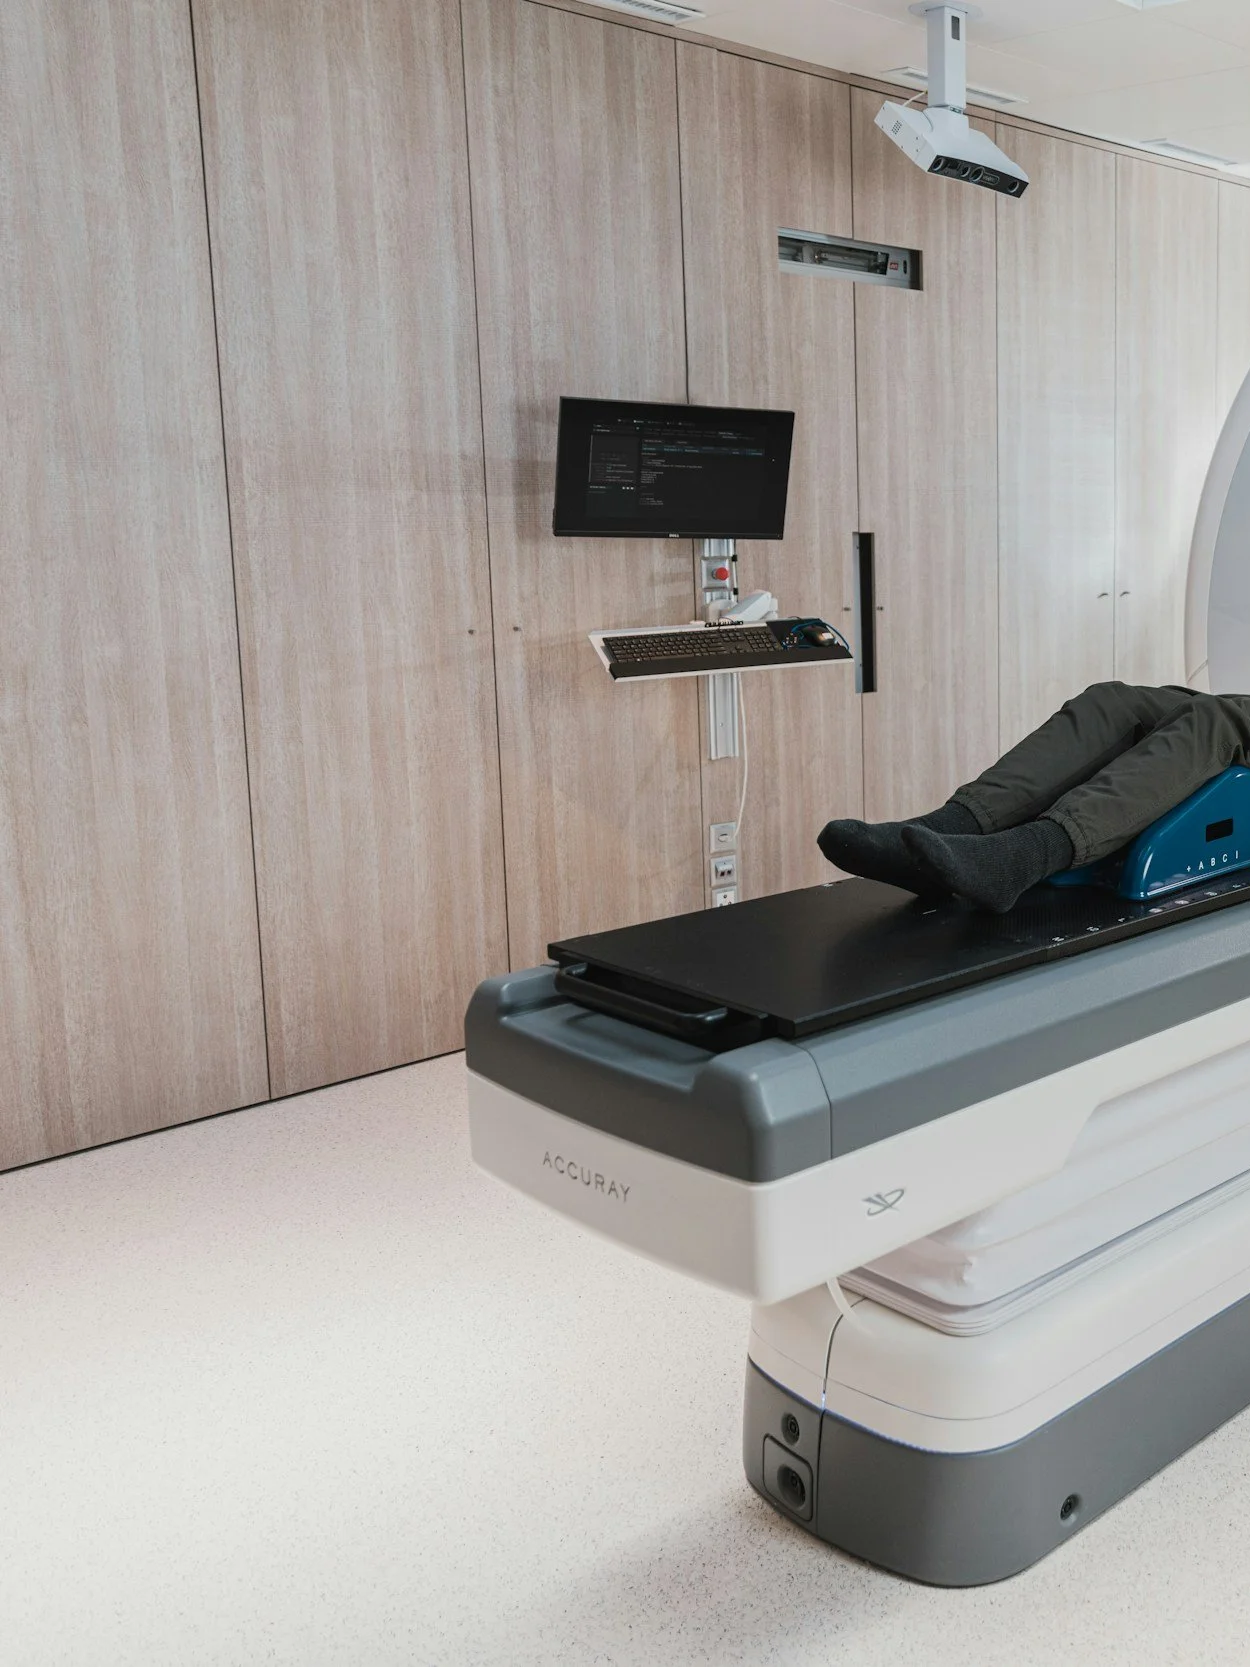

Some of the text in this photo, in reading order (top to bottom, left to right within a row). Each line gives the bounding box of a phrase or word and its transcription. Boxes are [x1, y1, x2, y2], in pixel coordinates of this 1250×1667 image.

[1198, 860, 1204, 870] A
[1210, 857, 1216, 867] B
[1222, 853, 1228, 863] C
[542, 1151, 631, 1203] ACCURAY
